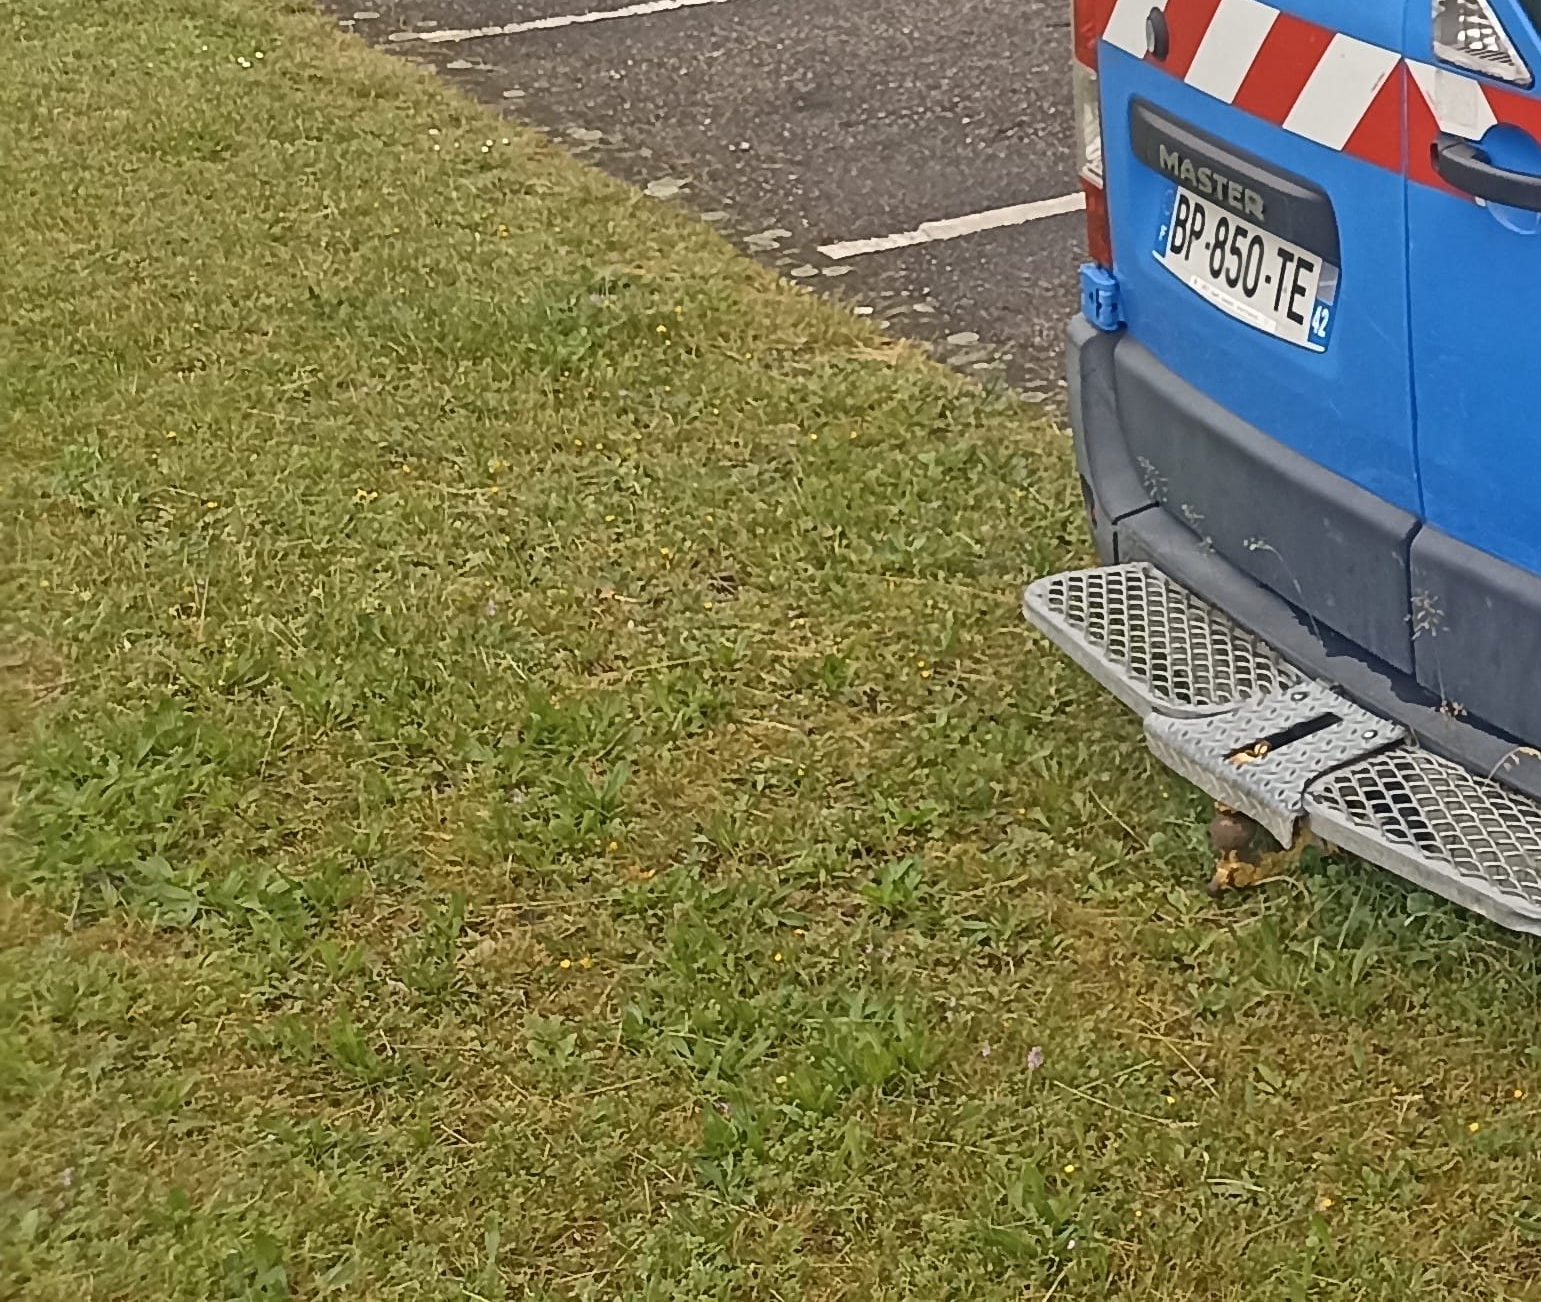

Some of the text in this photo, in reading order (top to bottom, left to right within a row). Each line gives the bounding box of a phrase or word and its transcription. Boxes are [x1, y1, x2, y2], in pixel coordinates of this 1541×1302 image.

[1158, 144, 1265, 222] MASTER
[1170, 194, 1314, 326] BP-850-TE
[1311, 304, 1330, 338] 42
